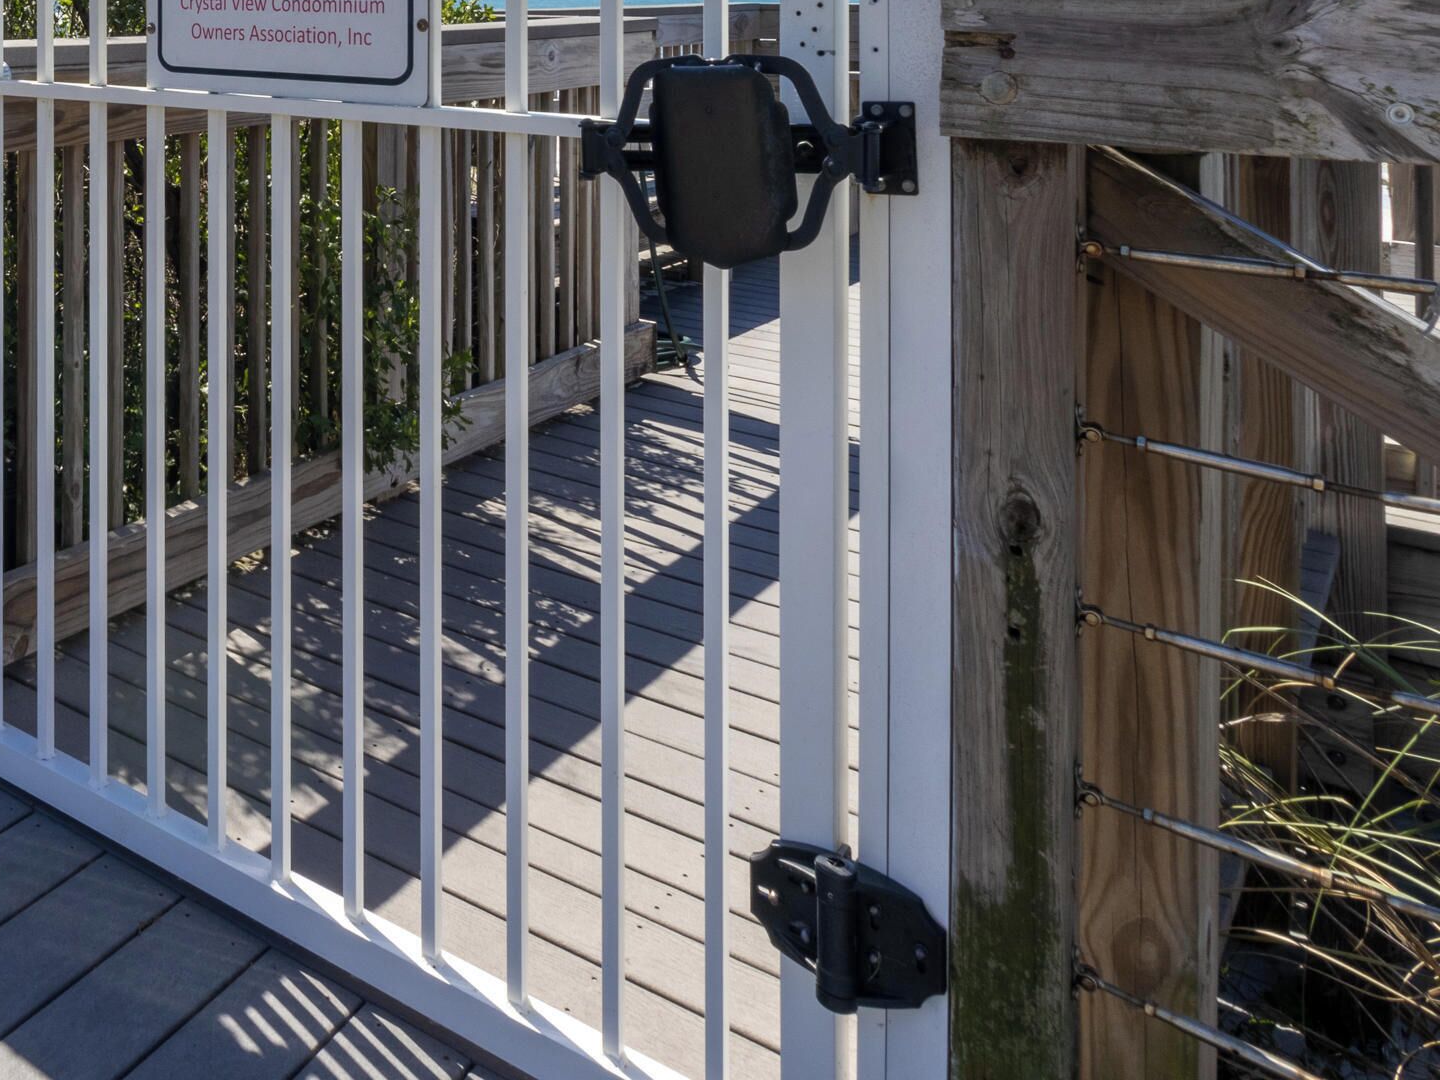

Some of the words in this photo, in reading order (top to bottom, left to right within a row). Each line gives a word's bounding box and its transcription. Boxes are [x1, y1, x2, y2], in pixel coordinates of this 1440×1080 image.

[190, 22, 245, 42] Owners
[249, 24, 343, 48] Association,
[347, 27, 373, 46] Inc
